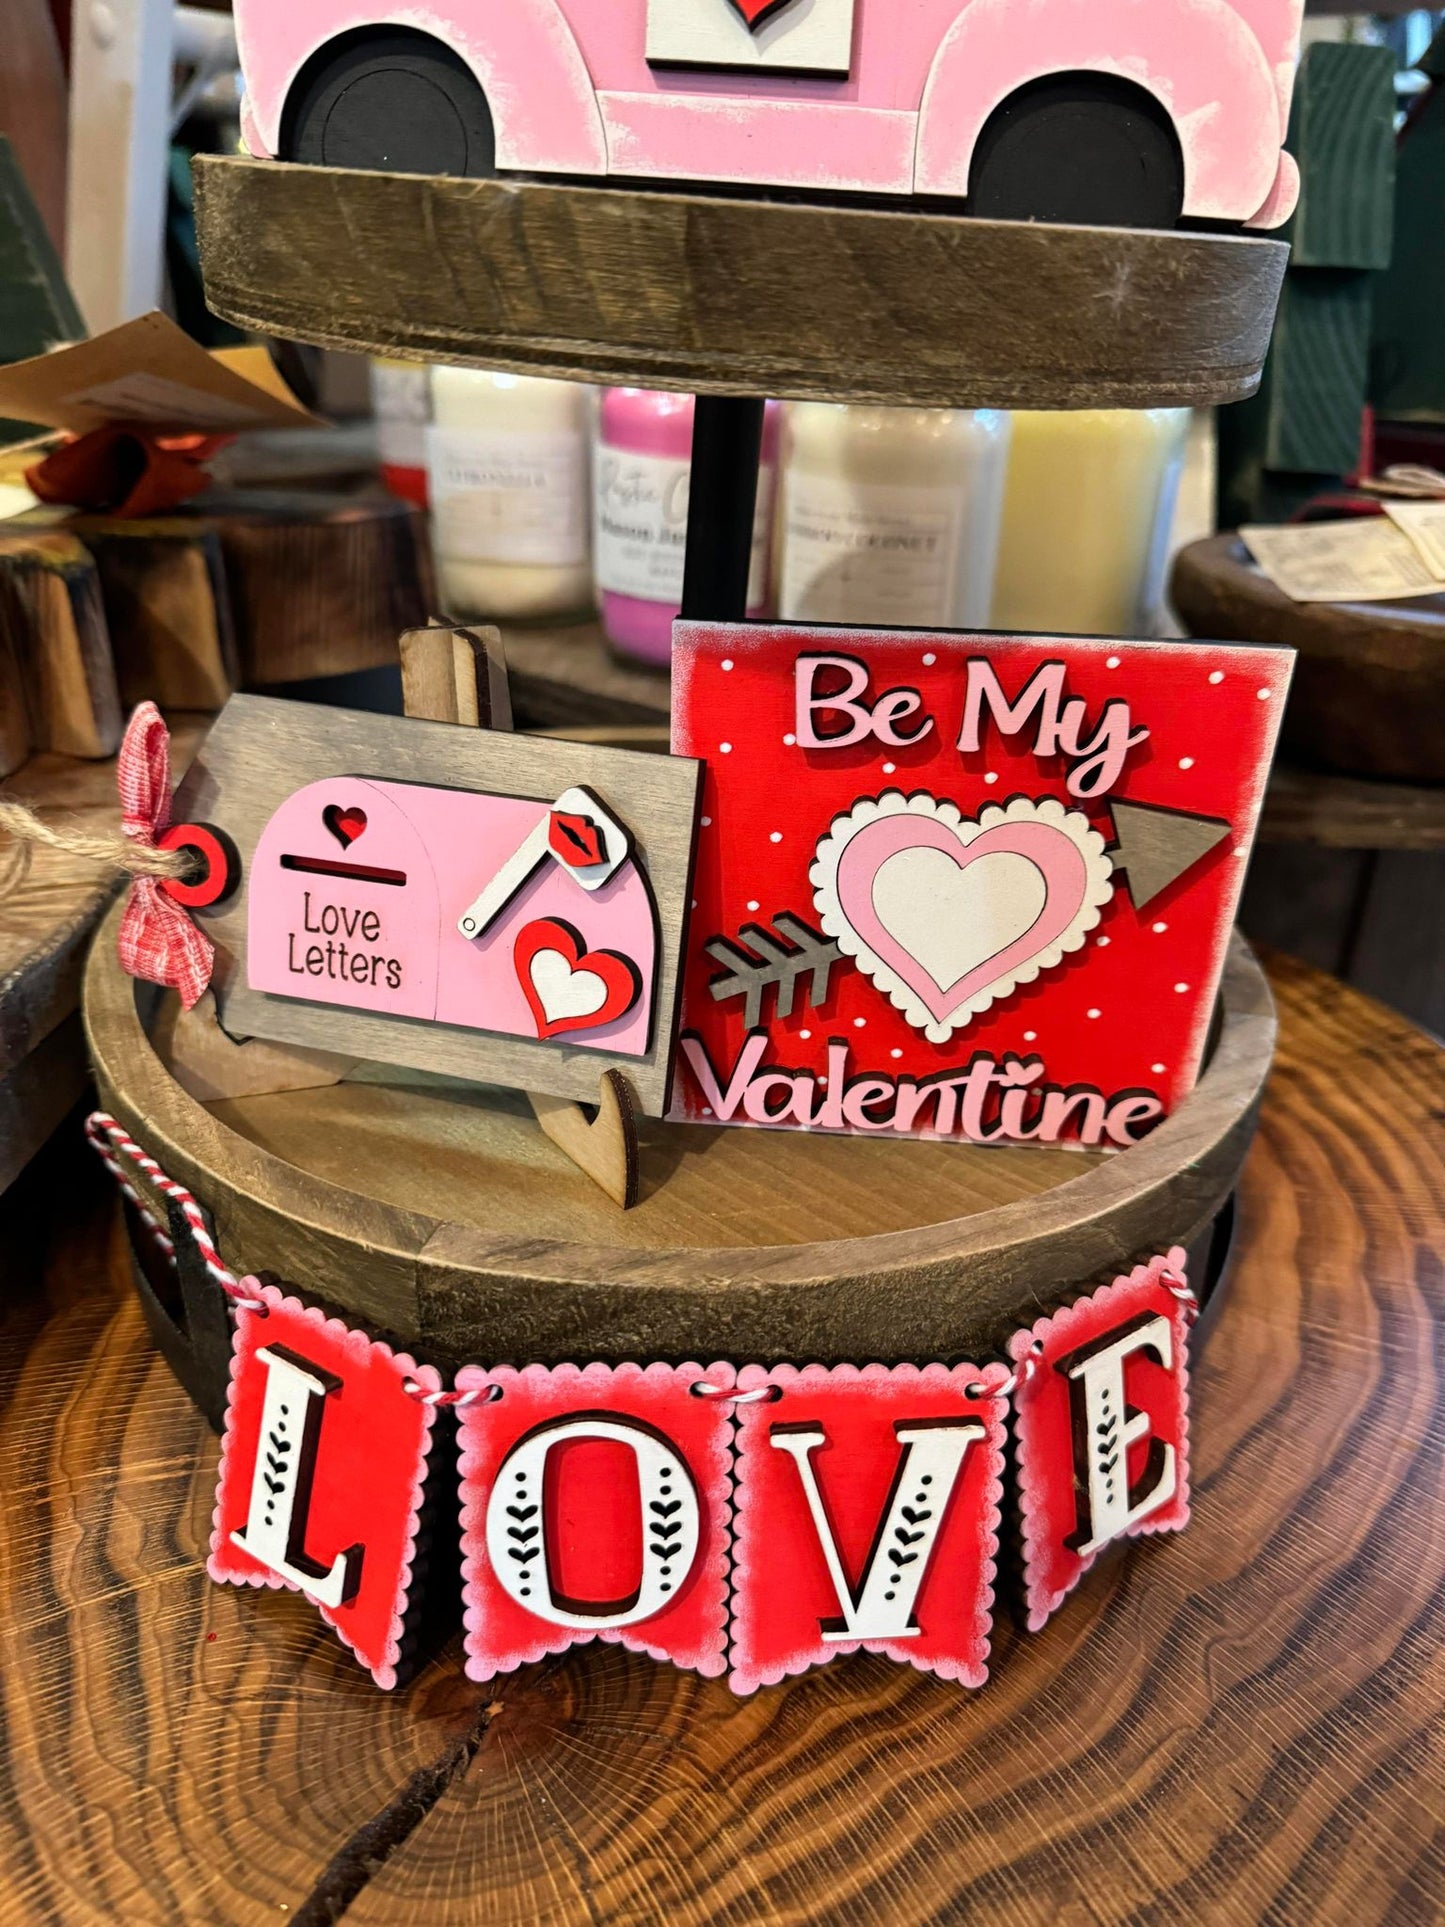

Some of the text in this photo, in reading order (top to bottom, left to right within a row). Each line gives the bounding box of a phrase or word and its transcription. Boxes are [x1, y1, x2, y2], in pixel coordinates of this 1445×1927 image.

[795, 654, 1151, 799] Be My
[287, 932, 403, 990] Letters
[303, 891, 382, 943] Love
[681, 1032, 1164, 1147] Valentine
[229, 1315, 1179, 1642] LOVE
